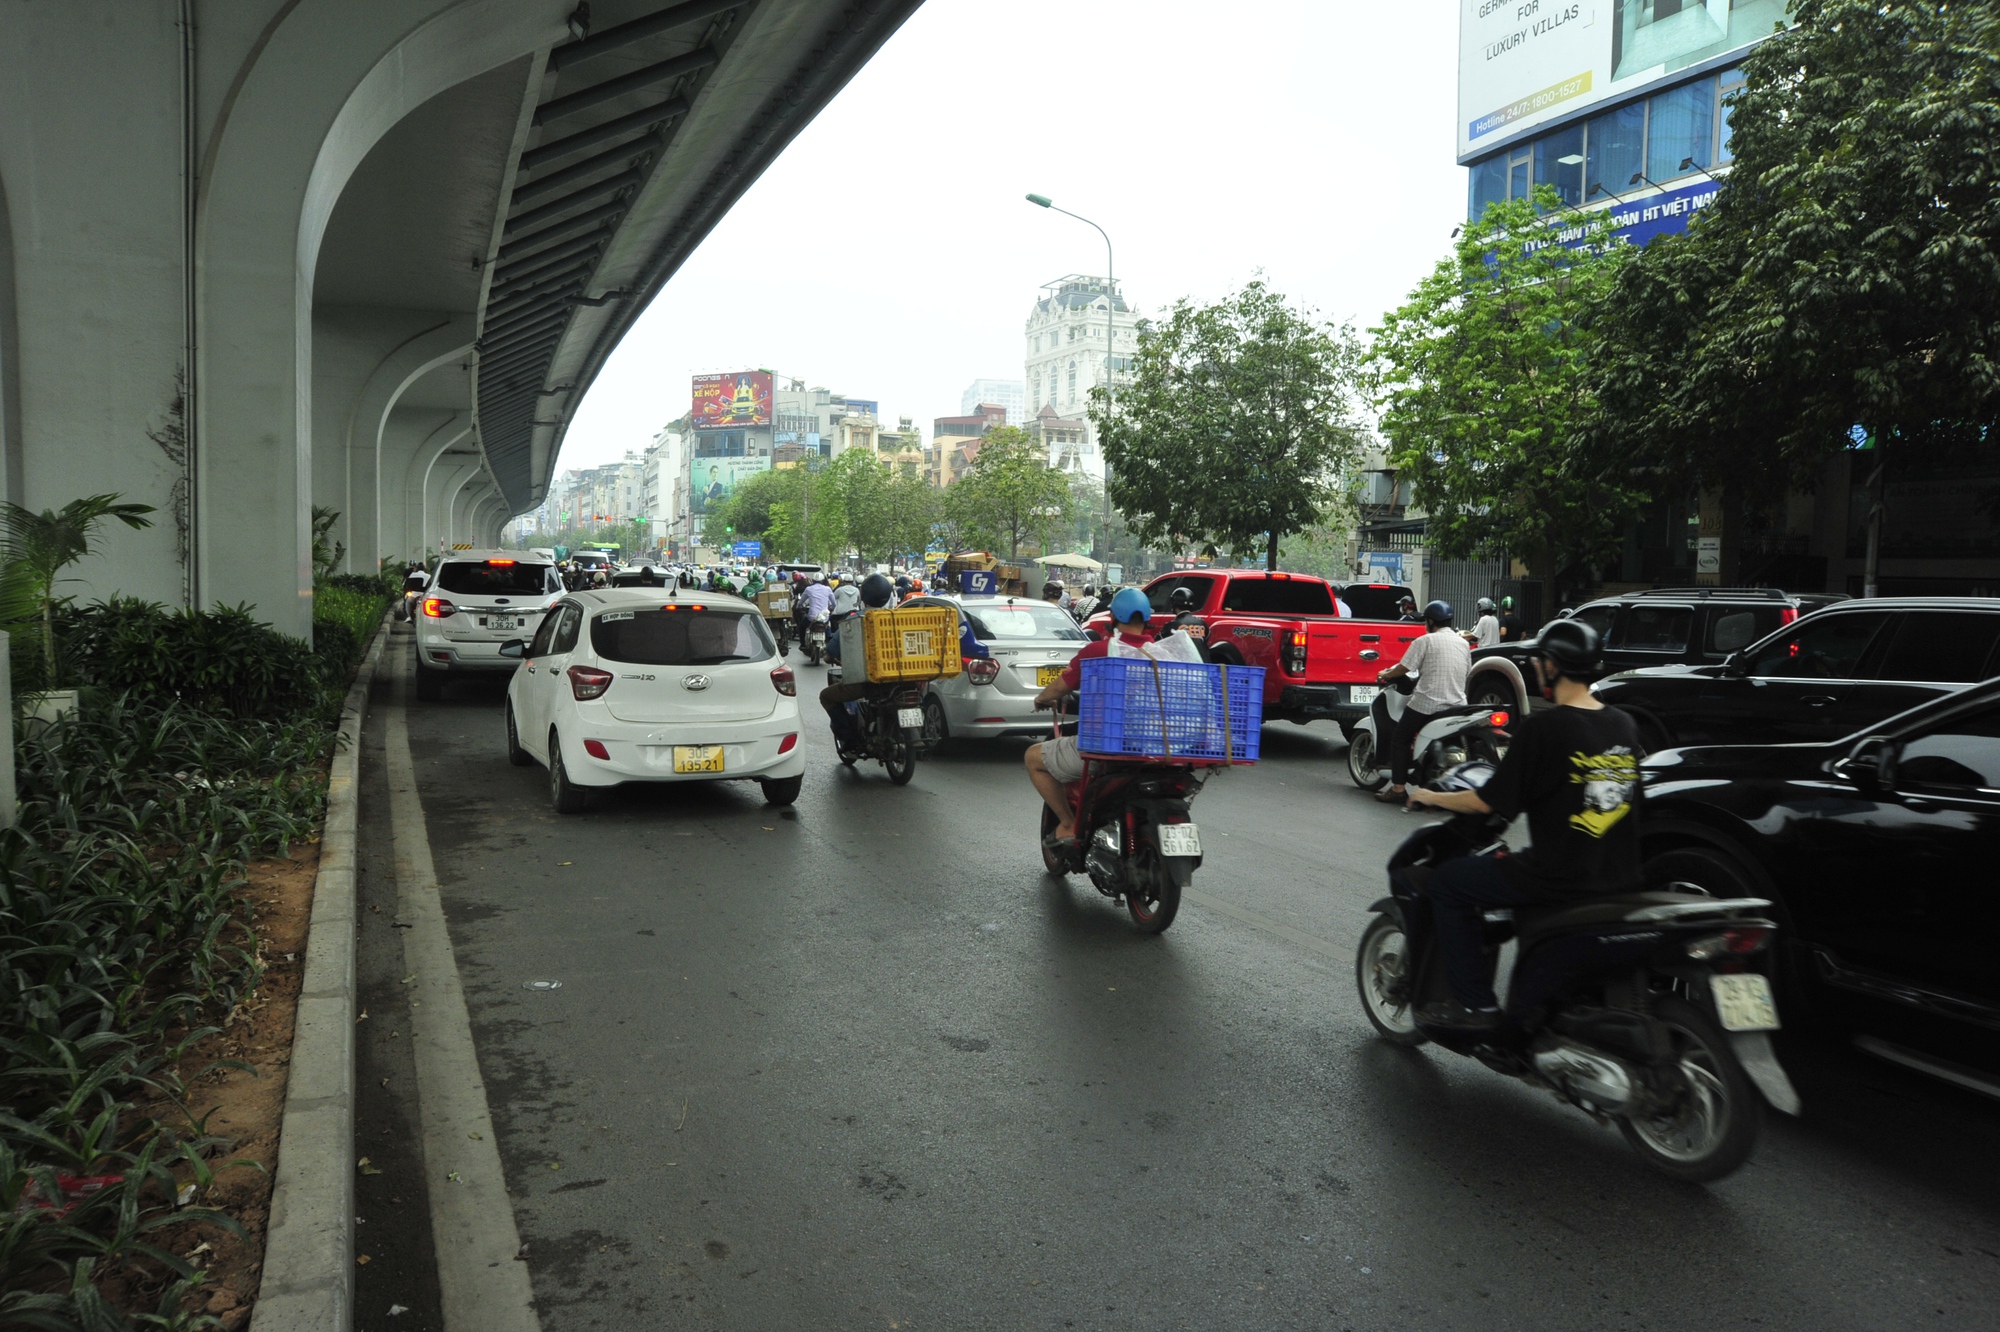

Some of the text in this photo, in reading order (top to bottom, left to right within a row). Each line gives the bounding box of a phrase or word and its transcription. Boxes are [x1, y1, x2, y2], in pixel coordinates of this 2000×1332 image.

[1518, 0, 1539, 21] FOR
[1486, 4, 1580, 61] LUXURY VILLAS
[1476, 79, 1583, 134] Hotline 24/7: 1800-1527
[1643, 206, 1661, 222] HT
[1661, 197, 1691, 217] VIỆT
[971, 573, 989, 592] G7
[1232, 625, 1275, 642] RAPTOR
[687, 747, 710, 760] 30E
[680, 759, 718, 772] 135.21
[1163, 840, 1200, 853] 561.62
